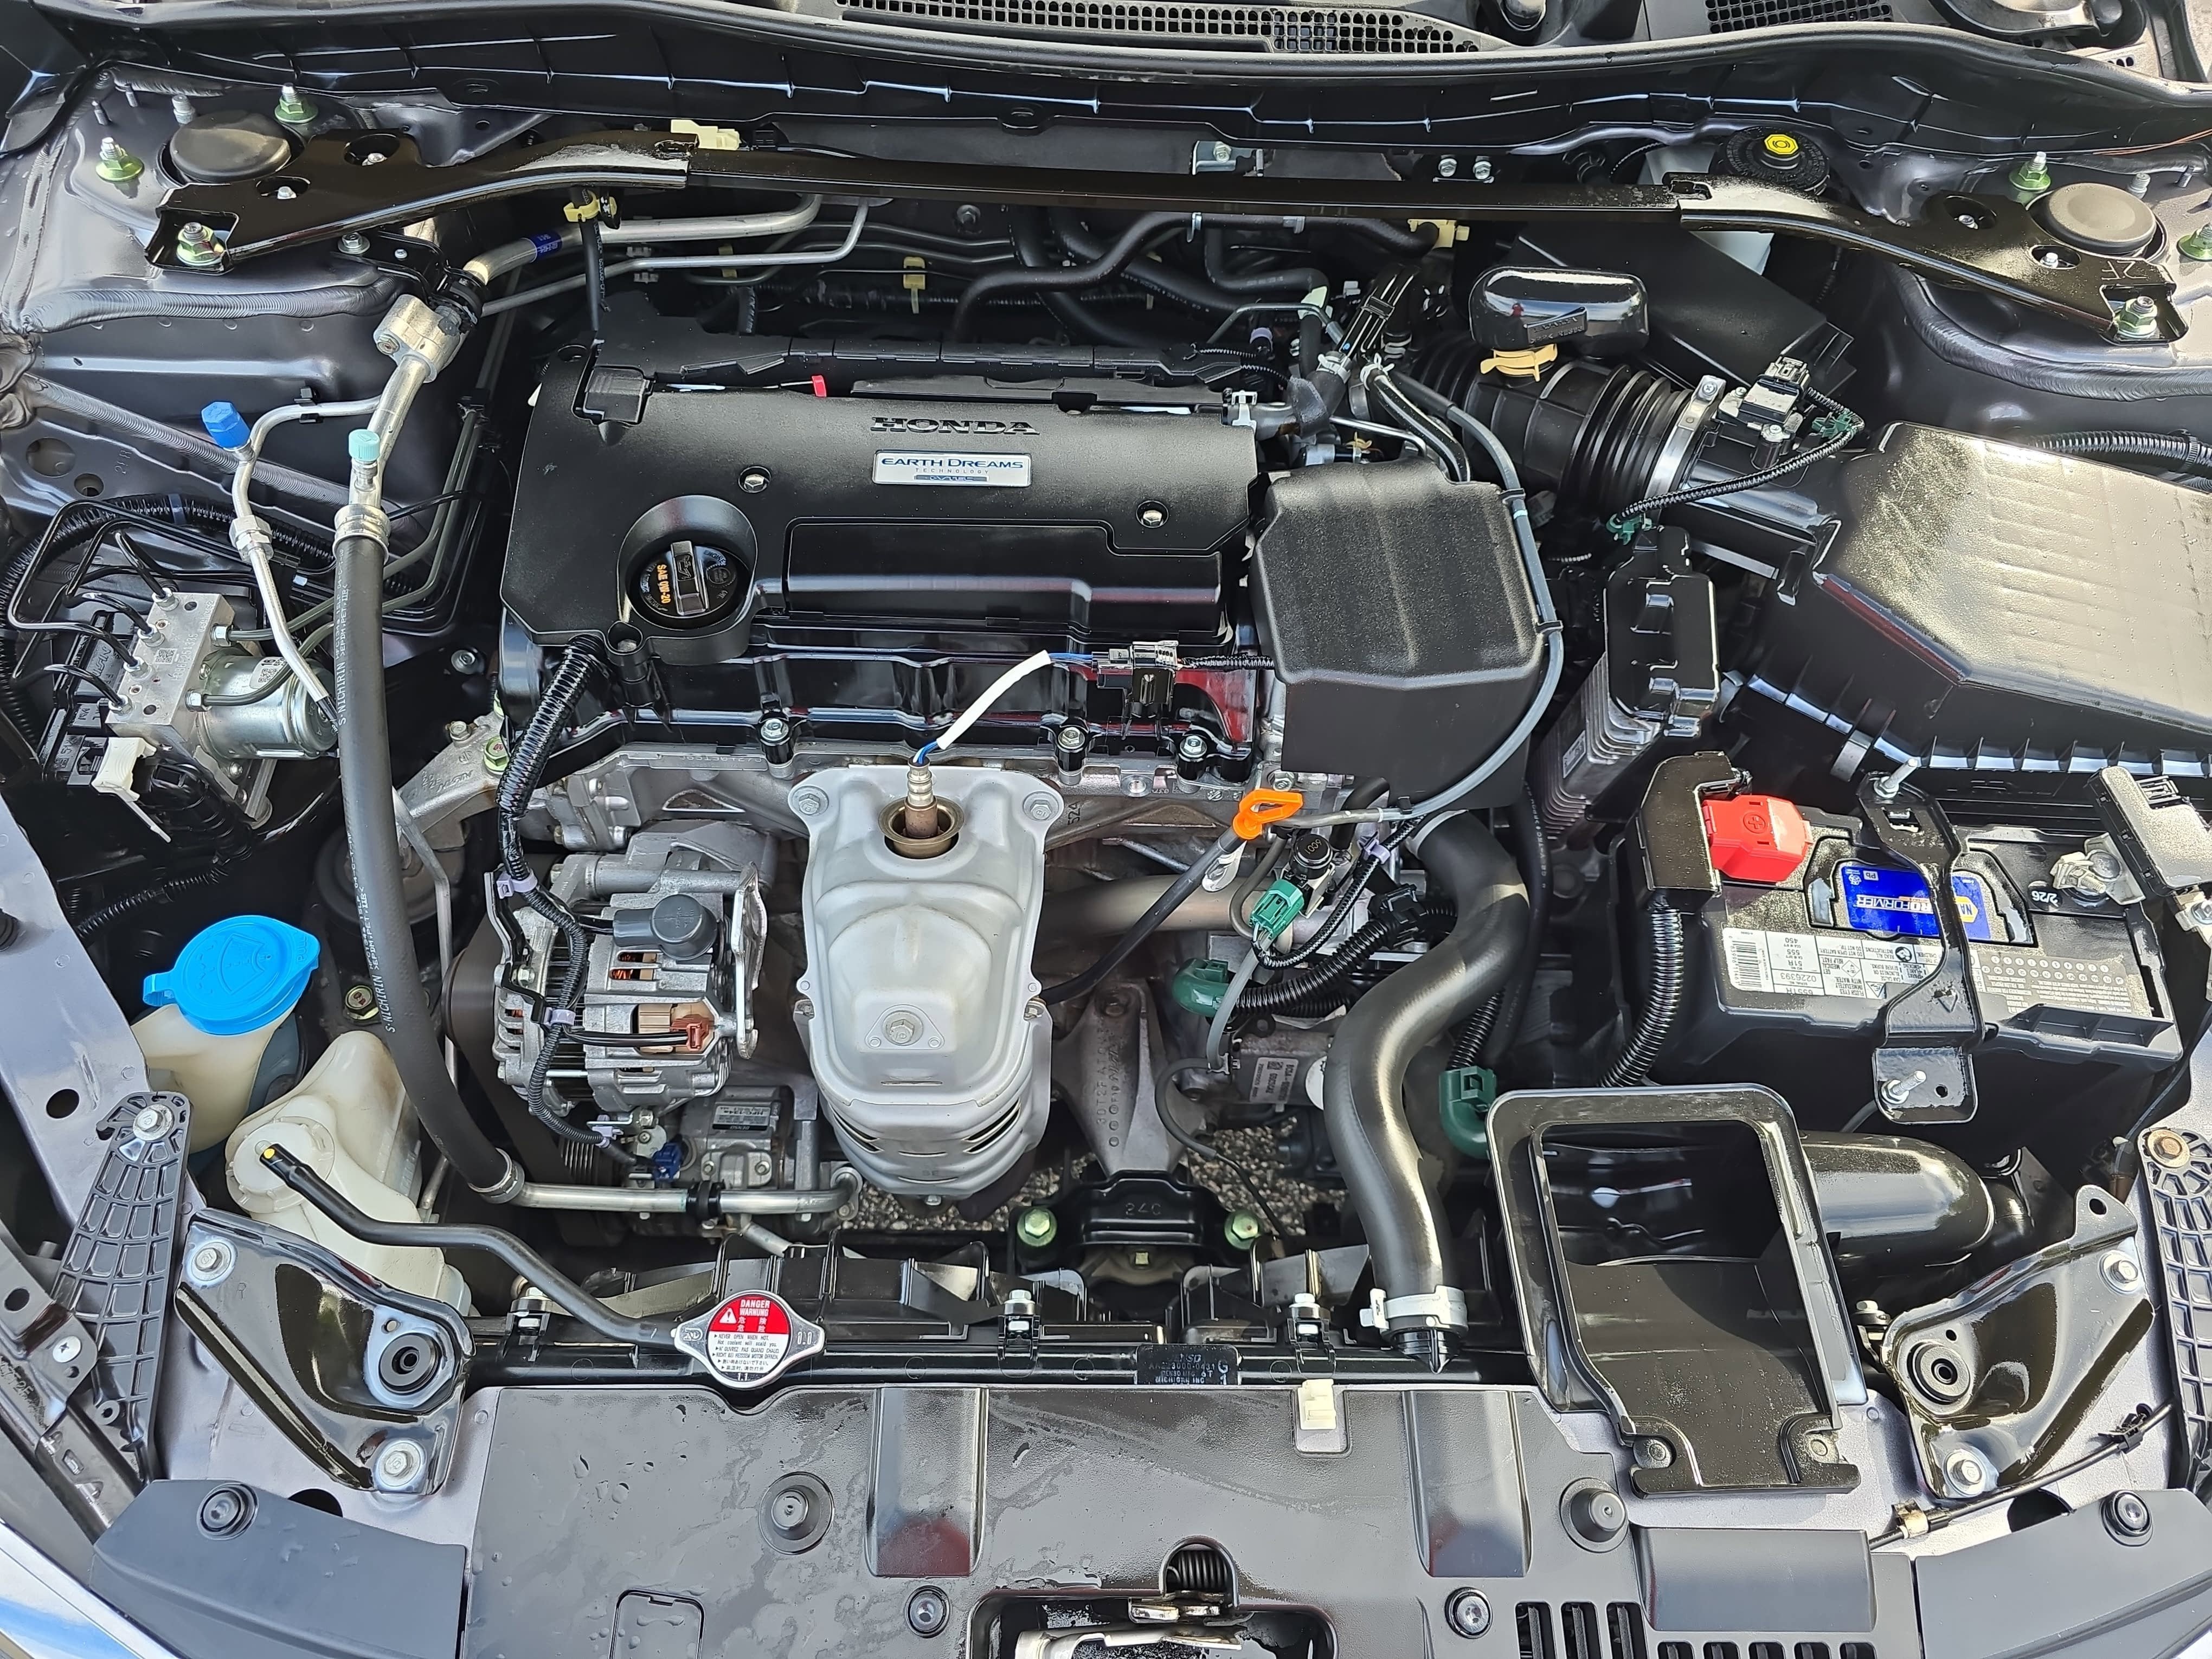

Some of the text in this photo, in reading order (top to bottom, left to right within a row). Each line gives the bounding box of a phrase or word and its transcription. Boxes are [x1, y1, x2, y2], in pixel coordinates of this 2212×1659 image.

[870, 417, 1040, 435] HONDA
[882, 458, 1024, 468] EARTH DREAMS
[657, 564, 667, 580] SAE
[1304, 839, 1321, 854] 6C01
[2030, 890, 2058, 903] 2/26
[1855, 896, 1972, 915] NA ROFORMER
[1779, 972, 1816, 982] 0226393
[740, 1300, 770, 1308] DANGER
[740, 1308, 769, 1316] WARNUNG
